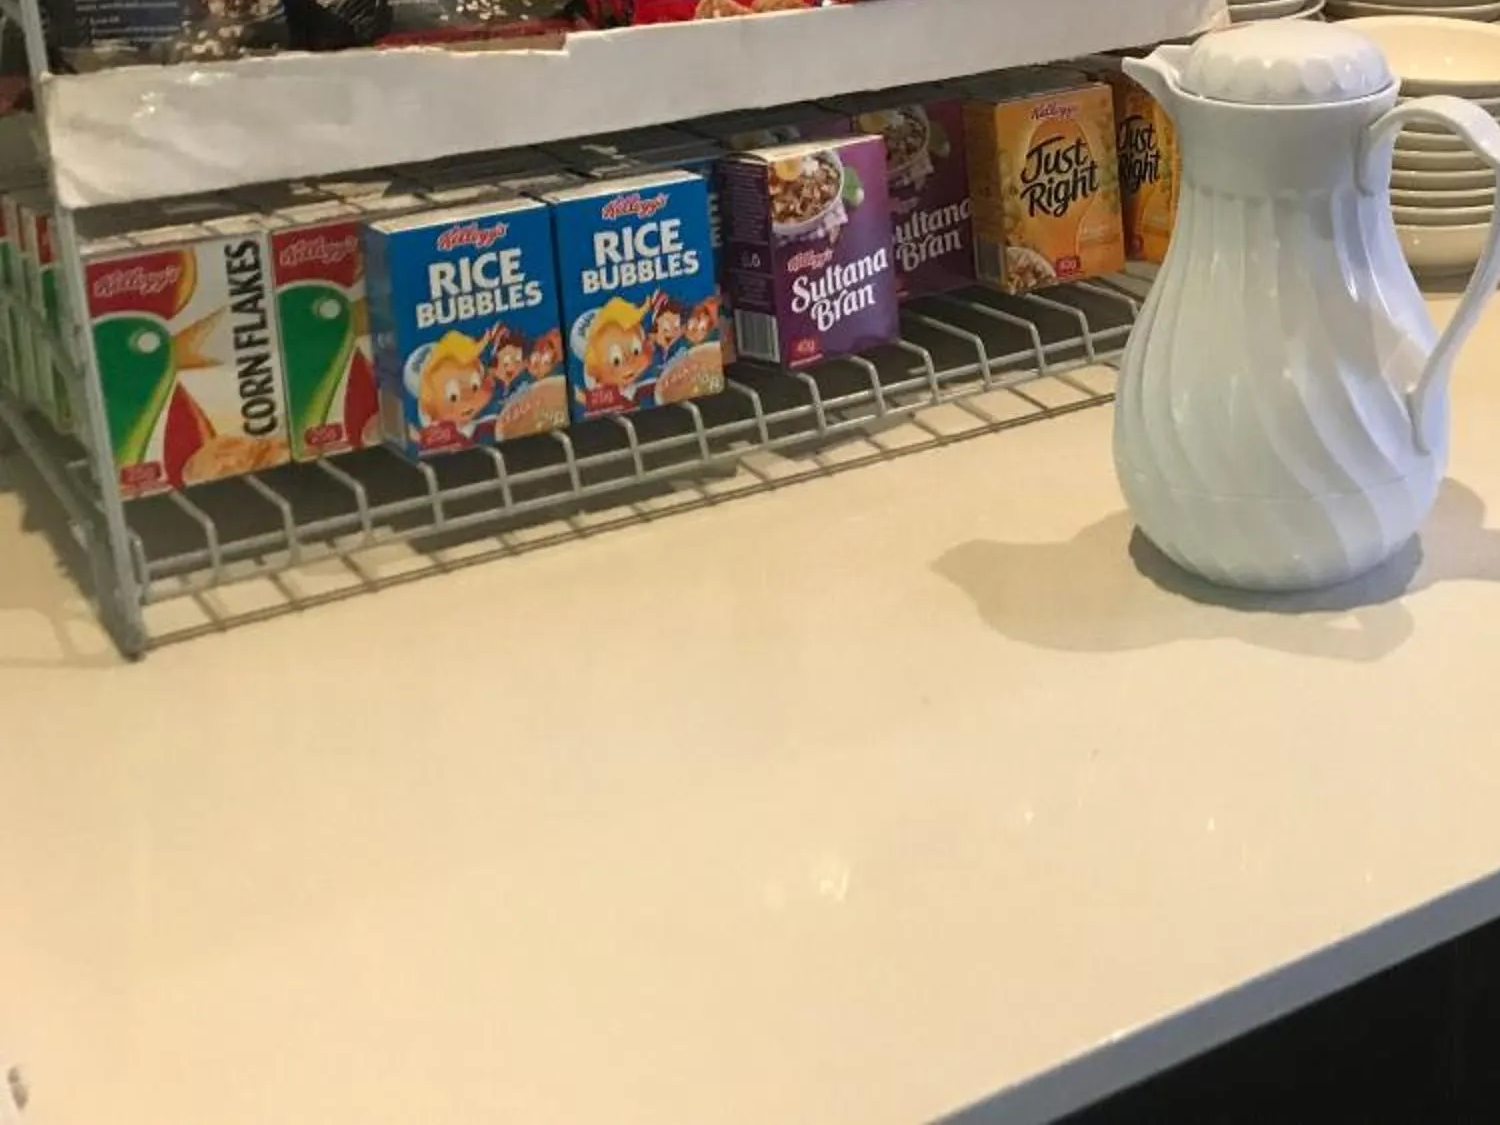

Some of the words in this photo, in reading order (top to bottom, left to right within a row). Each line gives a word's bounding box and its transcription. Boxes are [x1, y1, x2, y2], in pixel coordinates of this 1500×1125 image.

[1020, 136, 1088, 184] Just
[1020, 160, 1100, 218] Right
[593, 218, 685, 268] RICE
[892, 196, 972, 245] ultana
[427, 247, 526, 299] RICE
[581, 249, 700, 296] BUBBLES
[896, 226, 962, 272] Bran
[224, 239, 270, 351] FLAKES
[415, 280, 544, 330] BUBBLES
[790, 247, 889, 314] Sultana
[810, 282, 877, 332] Bran
[235, 352, 278, 437] CORN
